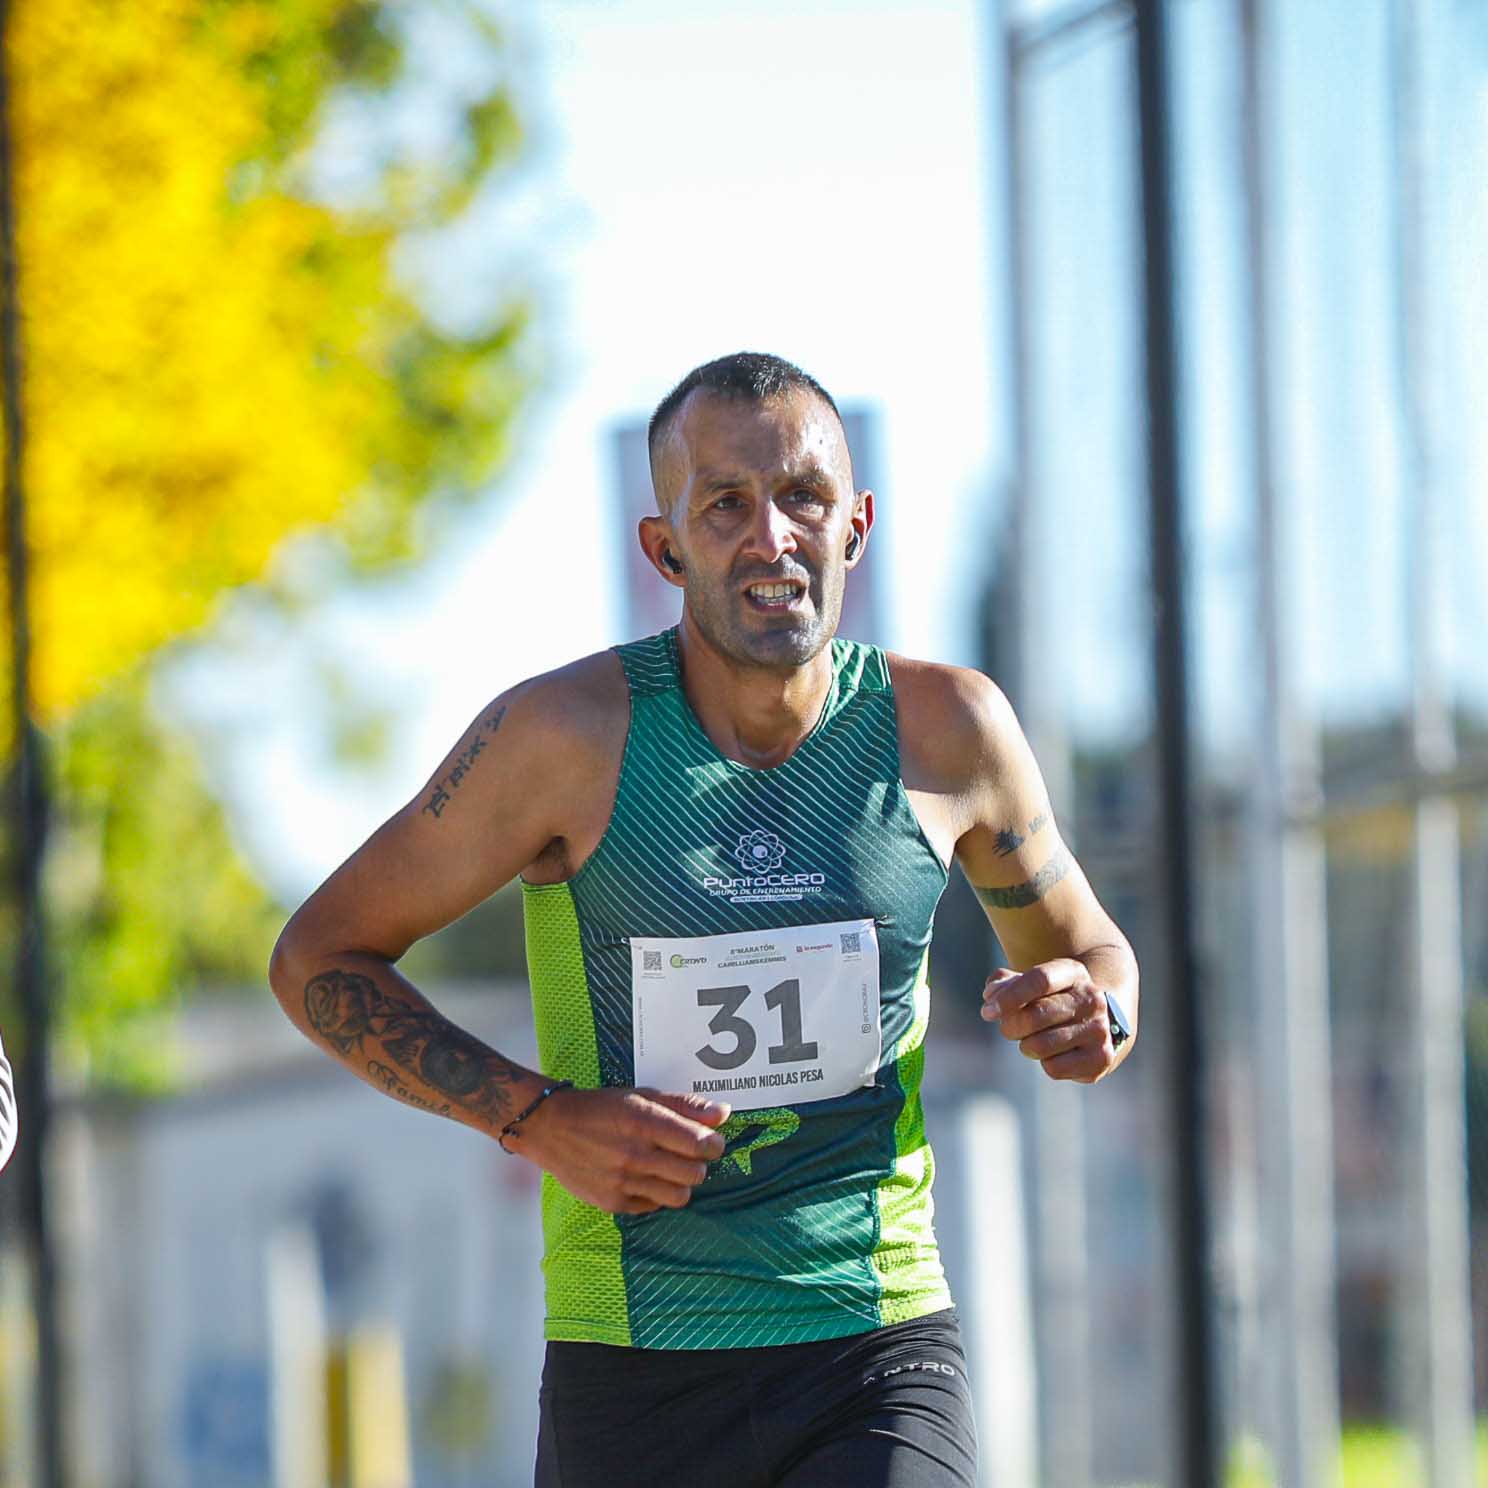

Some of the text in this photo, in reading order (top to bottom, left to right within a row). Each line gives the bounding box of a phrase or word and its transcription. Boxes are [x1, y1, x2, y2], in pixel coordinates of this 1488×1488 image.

[695, 978, 818, 1070] 31
[693, 1068, 824, 1093] MAXIMILIANO NICOLAS PESA
